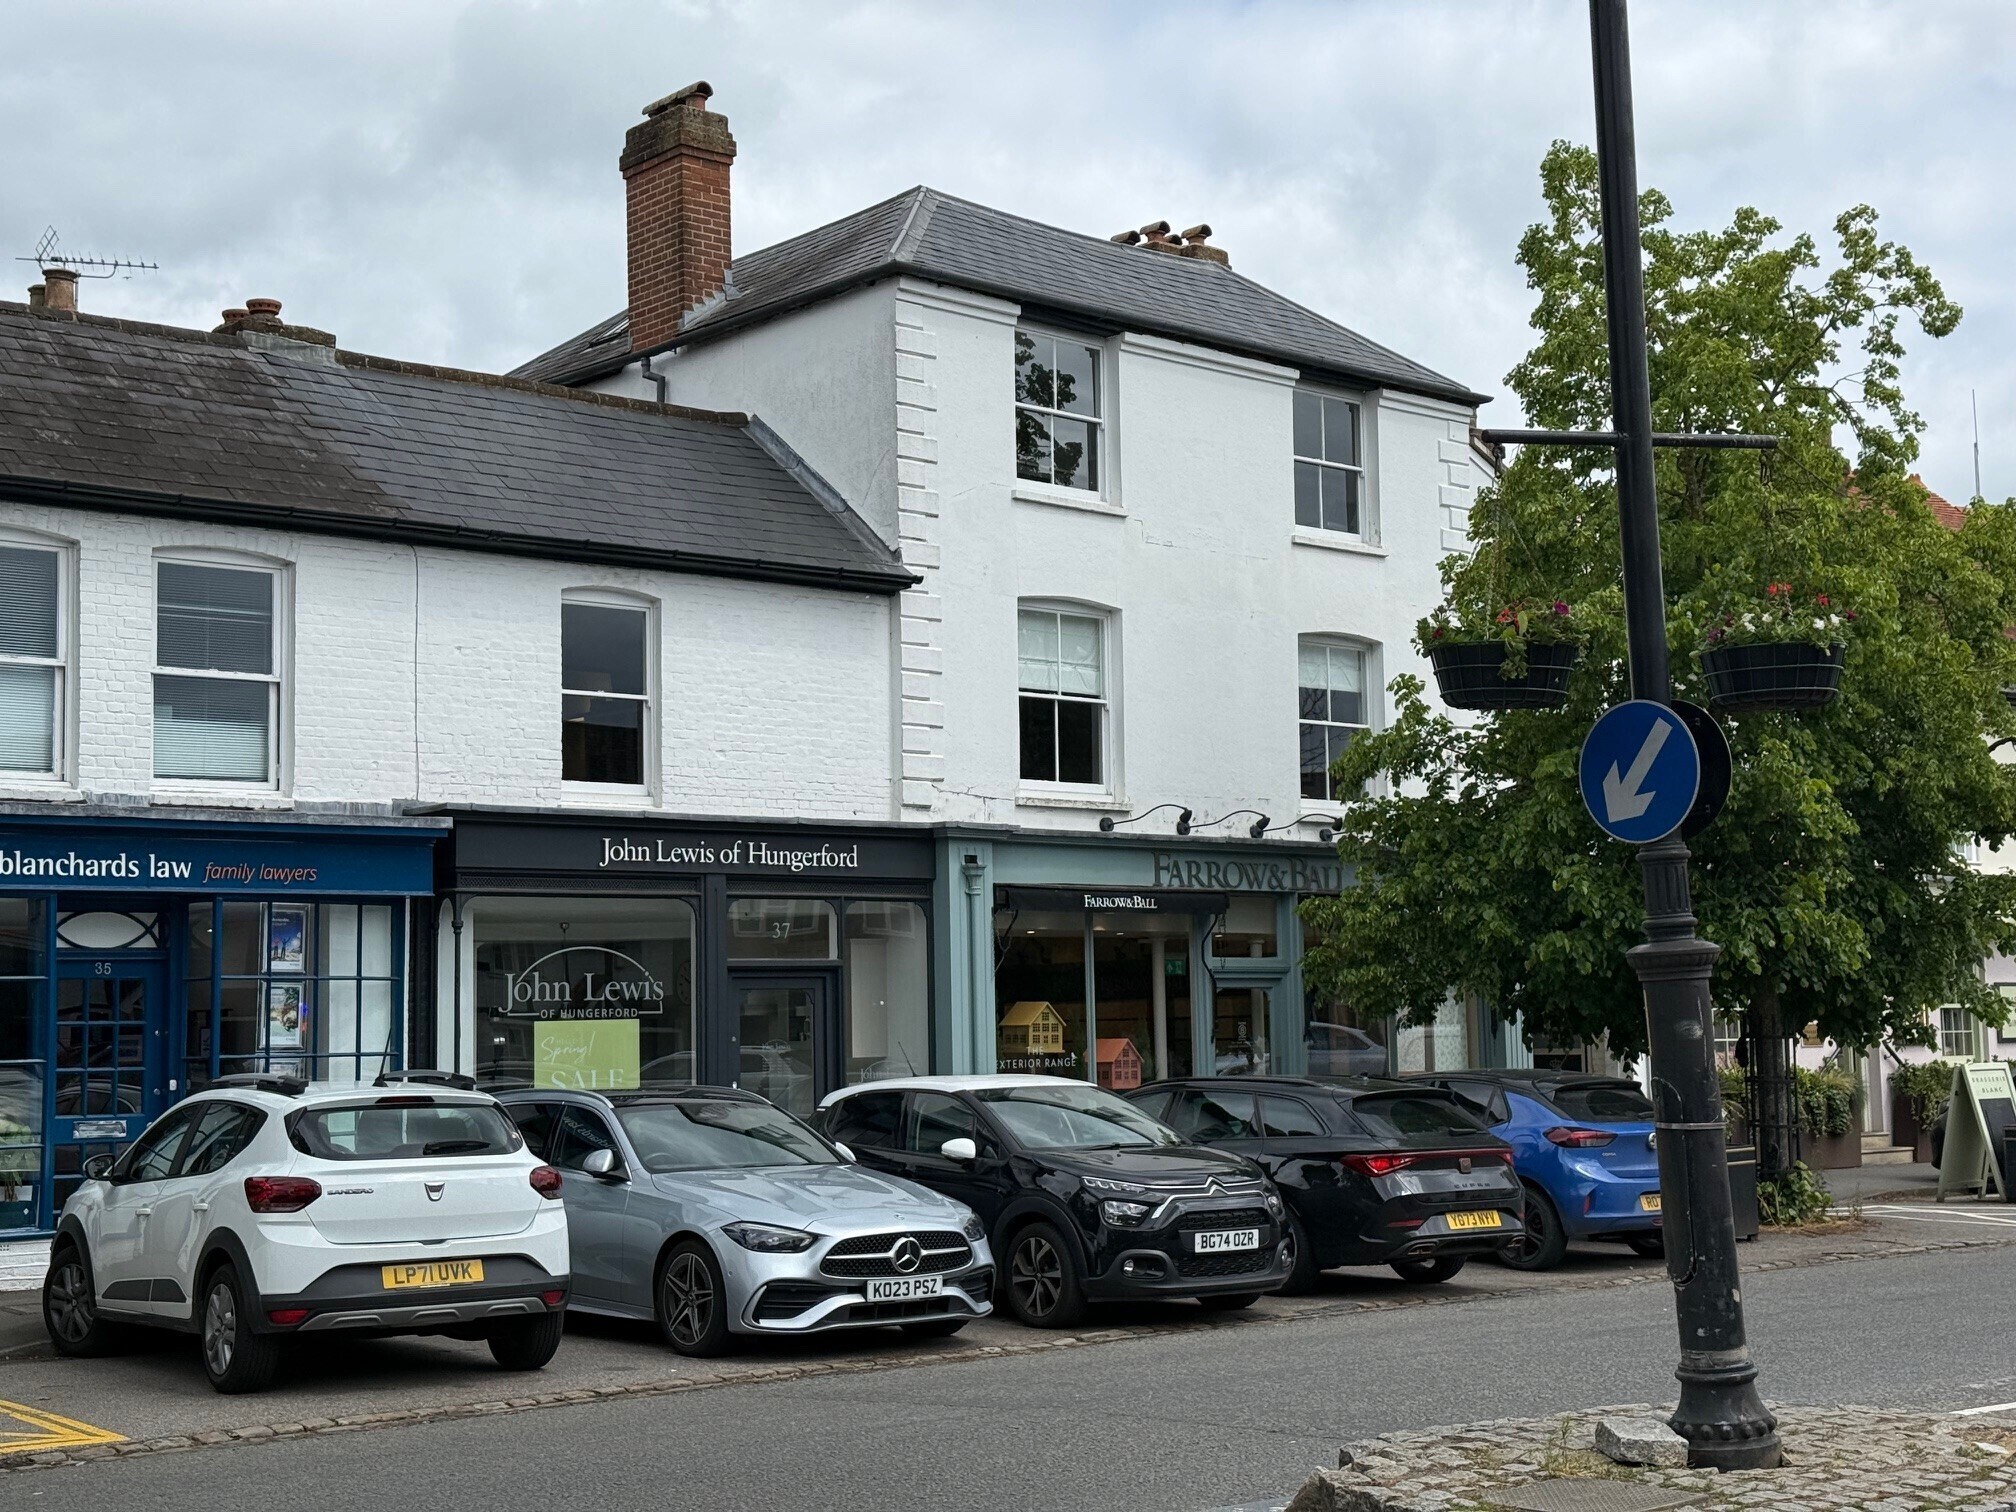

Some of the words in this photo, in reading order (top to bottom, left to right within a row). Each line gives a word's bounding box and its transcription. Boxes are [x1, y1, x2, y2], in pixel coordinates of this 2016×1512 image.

[599, 837, 650, 867] John
[656, 840, 715, 864] Lewis
[719, 840, 742, 864] of
[748, 842, 858, 871] Hungerford
[0, 851, 139, 878] blanchards
[149, 854, 191, 878] law
[203, 862, 255, 884] family
[259, 864, 317, 884] lawyers
[1084, 894, 1157, 909] FARROW&BALL
[772, 922, 790, 939] 37
[95, 962, 111, 974] 35
[498, 971, 572, 1013] John
[583, 971, 664, 1001] Lewis
[541, 1009, 555, 1019] OF
[560, 1008, 638, 1019] HUNGERFORD
[541, 1031, 596, 1065] Spring!
[1026, 1046, 1044, 1056] THE
[996, 1059, 1041, 1070] XTERIOR
[1045, 1057, 1076, 1068] RANGE
[1201, 1233, 1230, 1249] BG74
[1233, 1231, 1254, 1247] OZR
[438, 1262, 473, 1280] UVK
[873, 1281, 910, 1299] KO23
[914, 1278, 937, 1296] PSZ
